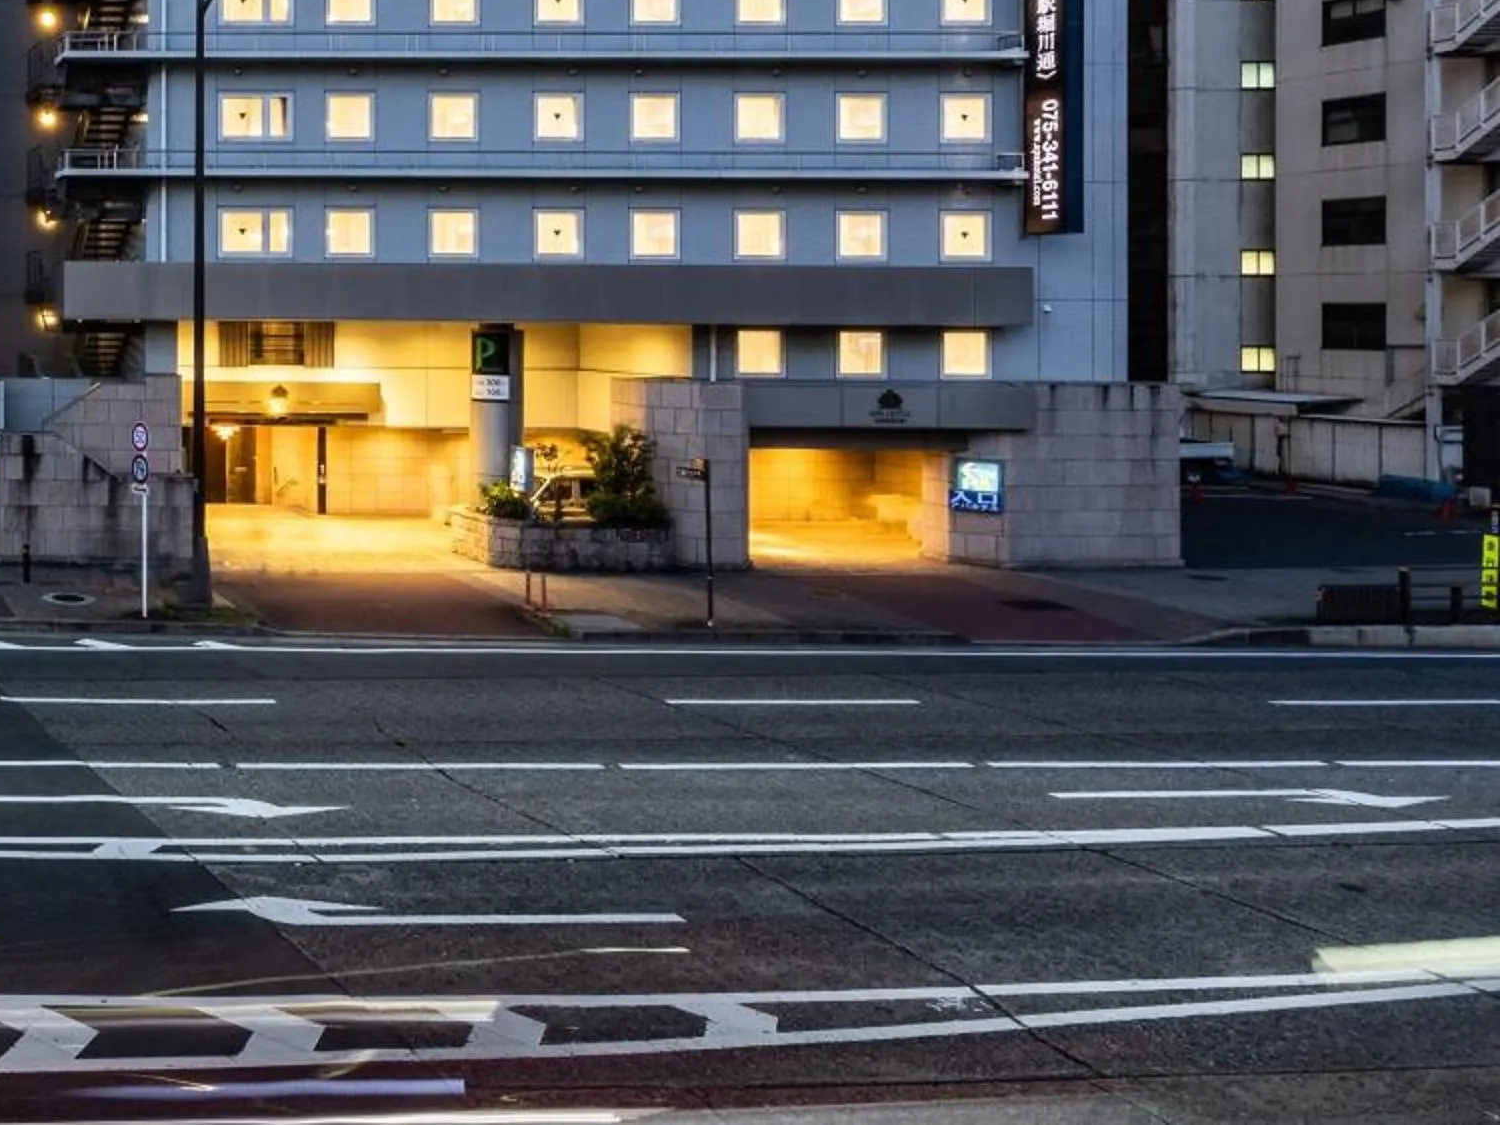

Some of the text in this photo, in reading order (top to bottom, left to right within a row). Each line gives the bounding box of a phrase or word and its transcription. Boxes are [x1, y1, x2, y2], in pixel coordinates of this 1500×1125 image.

[1041, 98, 1059, 220] 075-341-6111
[476, 337, 496, 370] P
[951, 490, 998, 504] 入口
